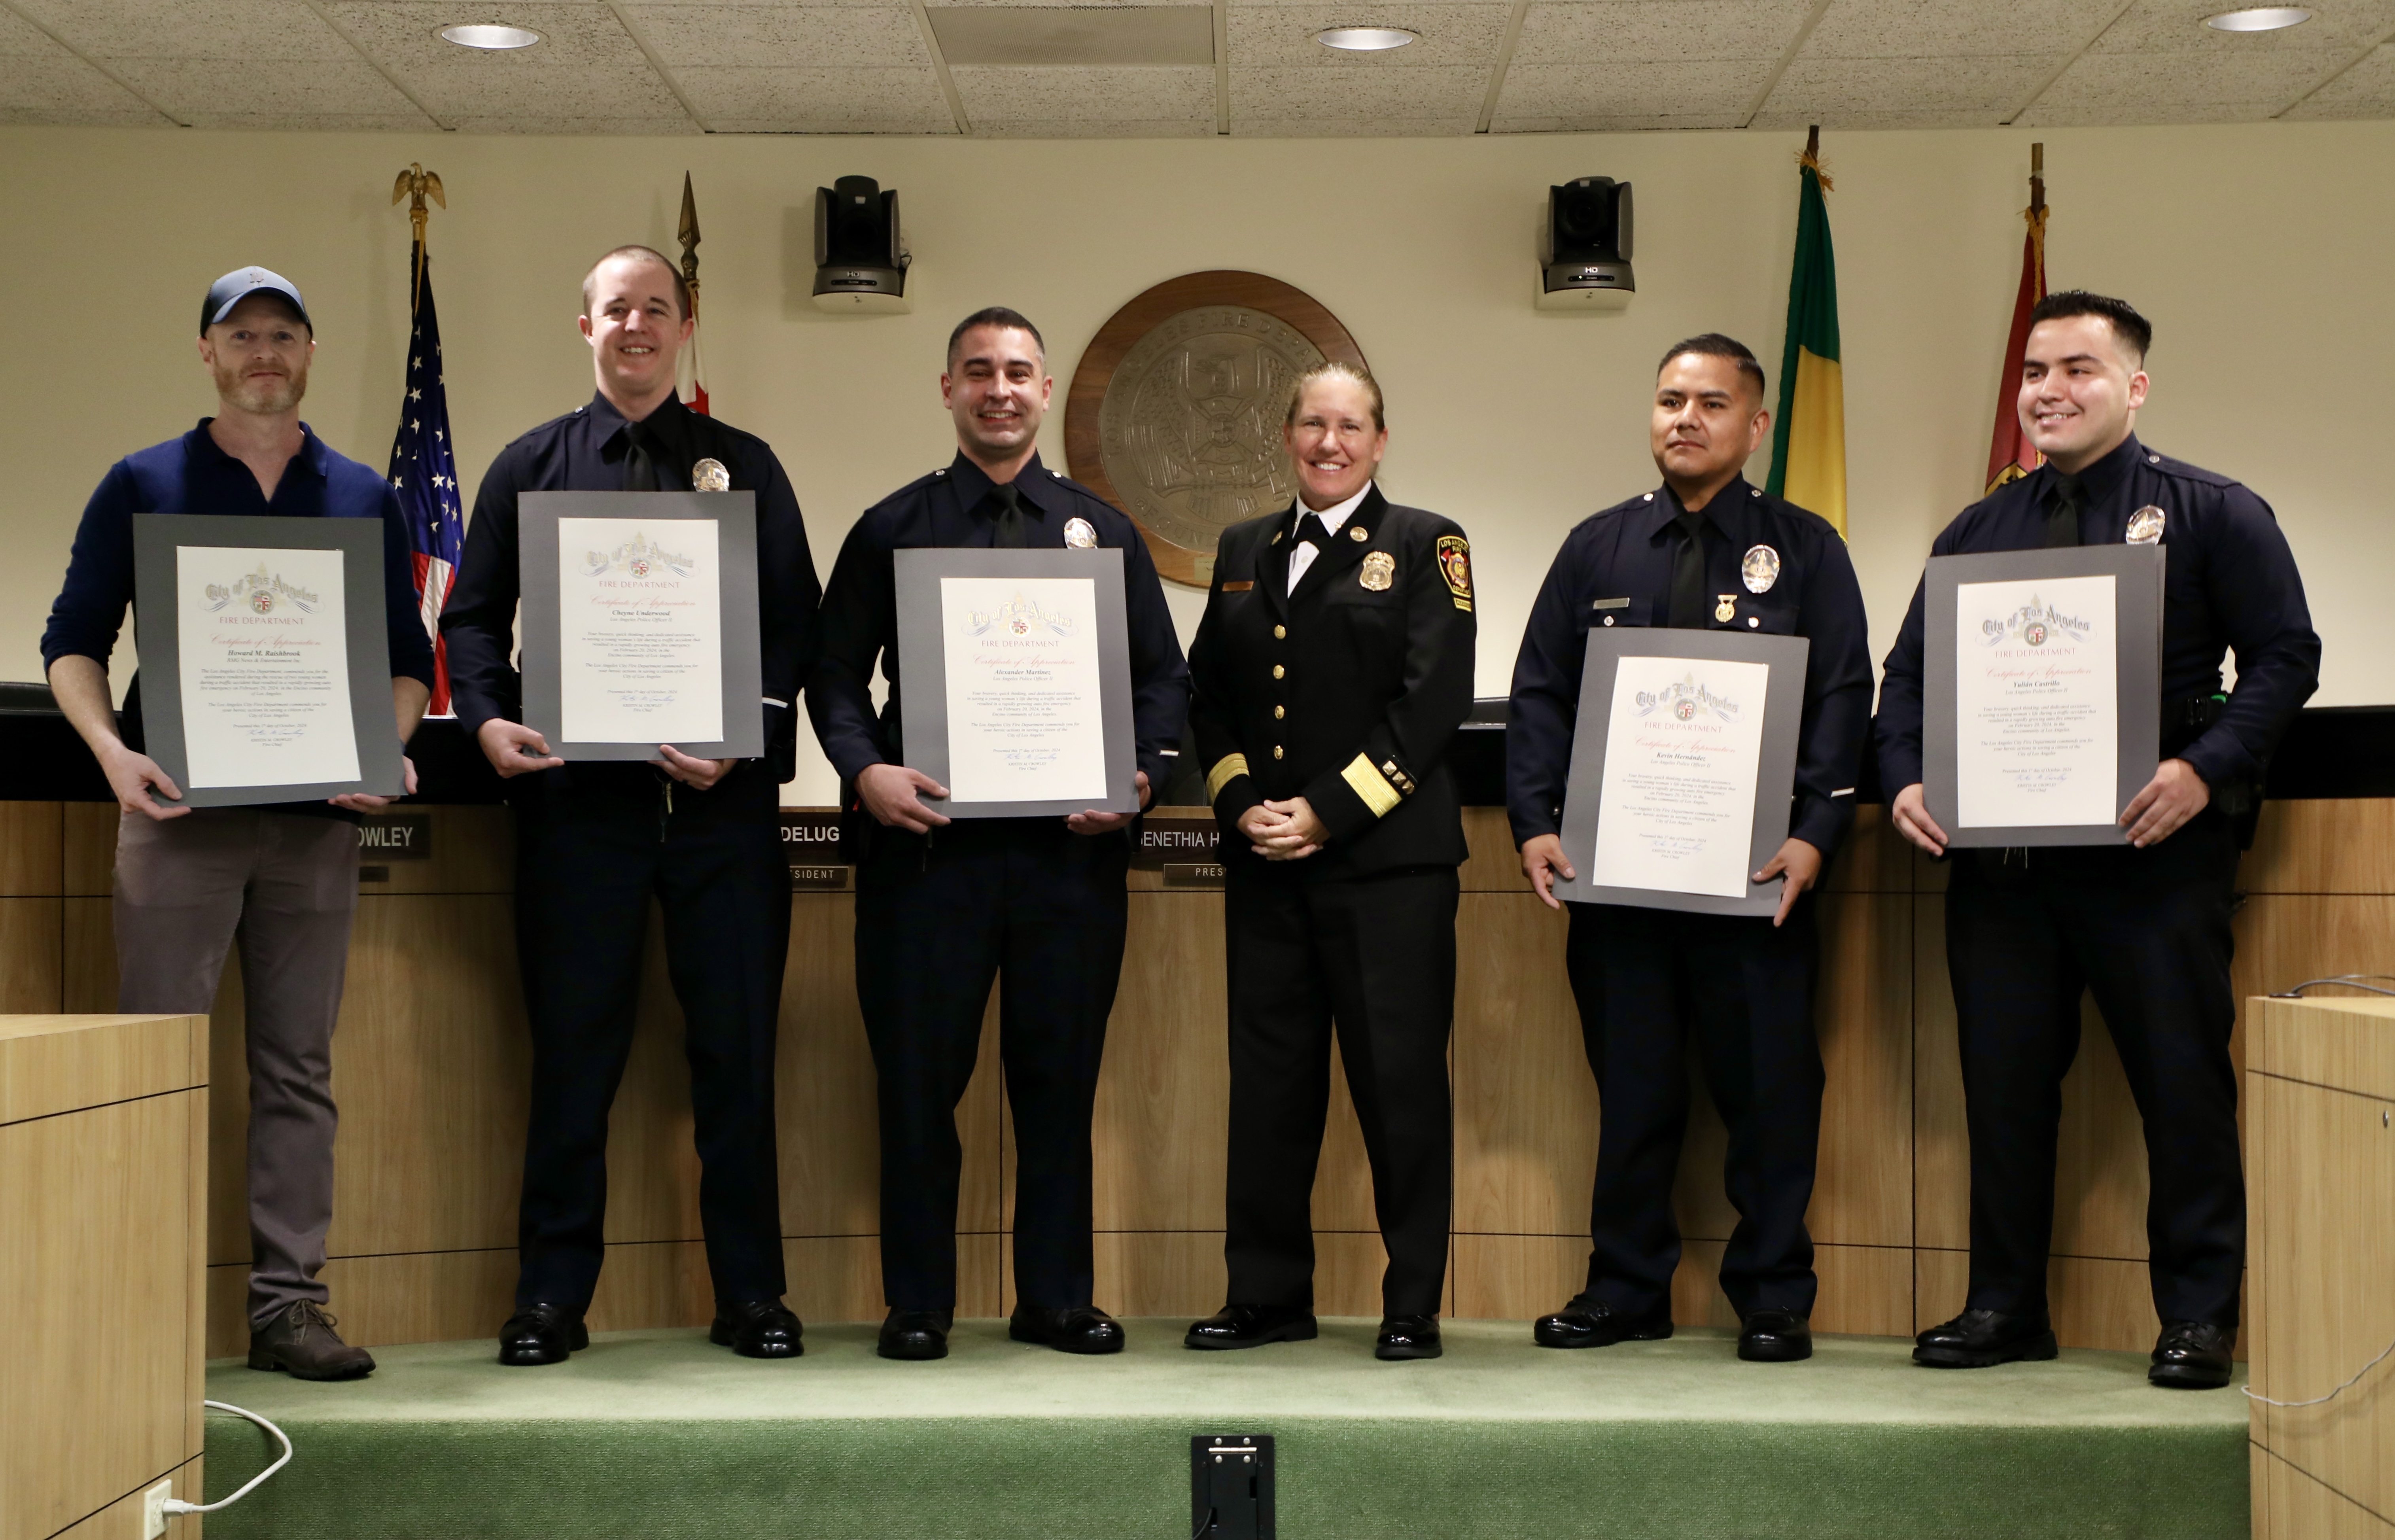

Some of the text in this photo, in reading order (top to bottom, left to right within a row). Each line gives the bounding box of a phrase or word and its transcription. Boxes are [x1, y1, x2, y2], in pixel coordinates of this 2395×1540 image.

[1198, 312, 1249, 329] FIRE
[1440, 539, 1451, 548] LOS
[205, 573, 319, 602] City of Los Angeles
[590, 594, 696, 609] Certificate of Appreciation
[967, 601, 1072, 627] City of Los Angeles
[1983, 605, 2090, 635] City of Los Angeles
[210, 633, 321, 648] Certificate of Appreciation
[2017, 648, 2076, 657] DEPARTMENT
[973, 654, 1075, 668] Certificate of Appreciation
[1986, 664, 2092, 680] Certificate of Appreciation
[1636, 683, 1739, 712] City of Los Angeles
[1665, 723, 1723, 733] DEPARTMENT
[1635, 736, 1736, 753] Certificate of Appreciation
[1141, 831, 1205, 847] ENETHIA
[790, 870, 834, 878] SIDENT
